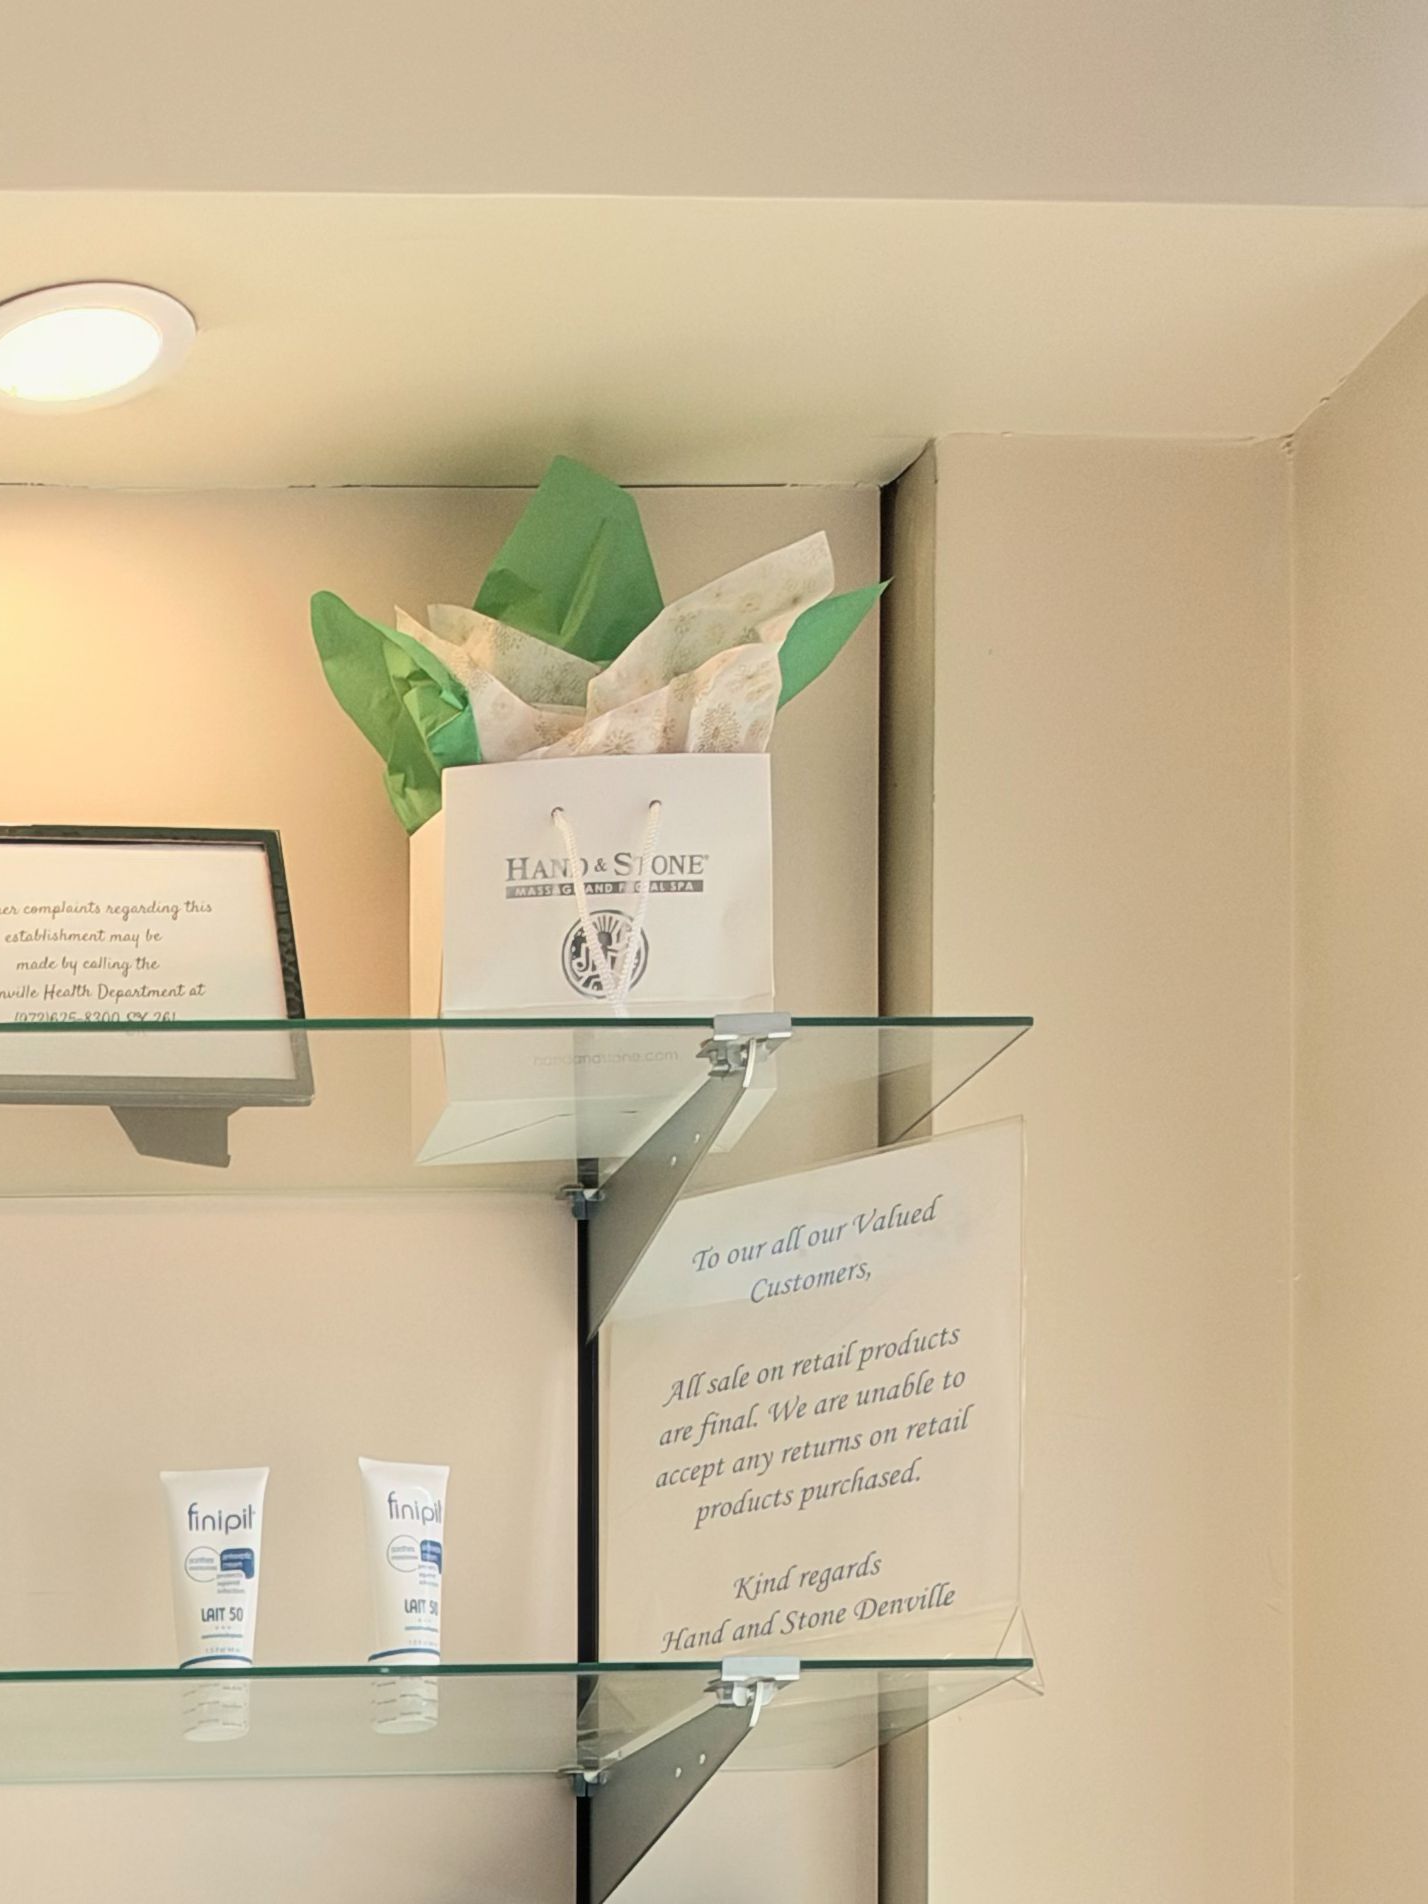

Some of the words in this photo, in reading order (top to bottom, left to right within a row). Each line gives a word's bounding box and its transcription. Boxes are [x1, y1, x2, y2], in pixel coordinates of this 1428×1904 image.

[596, 859, 606, 872] &
[670, 881, 694, 892] SPA
[23, 900, 101, 919] complaints
[106, 900, 180, 921] regarding
[184, 900, 212, 913] this
[4, 929, 106, 943] establishment
[110, 932, 140, 948] may
[145, 929, 163, 942] be
[16, 957, 57, 971] made
[62, 957, 78, 974] by
[82, 957, 132, 978] calling
[135, 957, 160, 971] the
[44, 984, 92, 1000] Health
[97, 983, 186, 1004] Department
[189, 984, 206, 996] at
[692, 1248, 720, 1274] To
[726, 1241, 767, 1266] our
[771, 1224, 806, 1257] all
[807, 1222, 848, 1248] our
[852, 1193, 941, 1237] Valued
[749, 1260, 873, 1305] Customers,
[662, 1372, 706, 1409] All
[706, 1368, 750, 1397] sale
[756, 1360, 786, 1385] on
[792, 1339, 857, 1378] retail
[857, 1325, 961, 1371] products
[658, 1421, 693, 1447] are
[693, 1403, 760, 1447] final.
[768, 1394, 808, 1423] We
[814, 1386, 849, 1413] are
[856, 1367, 936, 1407] unable
[942, 1368, 967, 1390] to
[655, 1456, 725, 1490] accept
[732, 1449, 775, 1477] any
[780, 1430, 863, 1465] returns
[869, 1424, 898, 1449] on
[905, 1403, 975, 1442] retail
[692, 1483, 793, 1531] products
[800, 1458, 923, 1511] purchased.
[188, 1502, 253, 1536] finipil
[732, 1563, 792, 1601] Kind
[798, 1549, 882, 1593] regards
[201, 1606, 225, 1622] LAIT
[229, 1606, 244, 1622] 50
[659, 1619, 725, 1655] Hand
[732, 1609, 775, 1641] and
[779, 1604, 847, 1636] Stone
[853, 1581, 957, 1621] Denville
